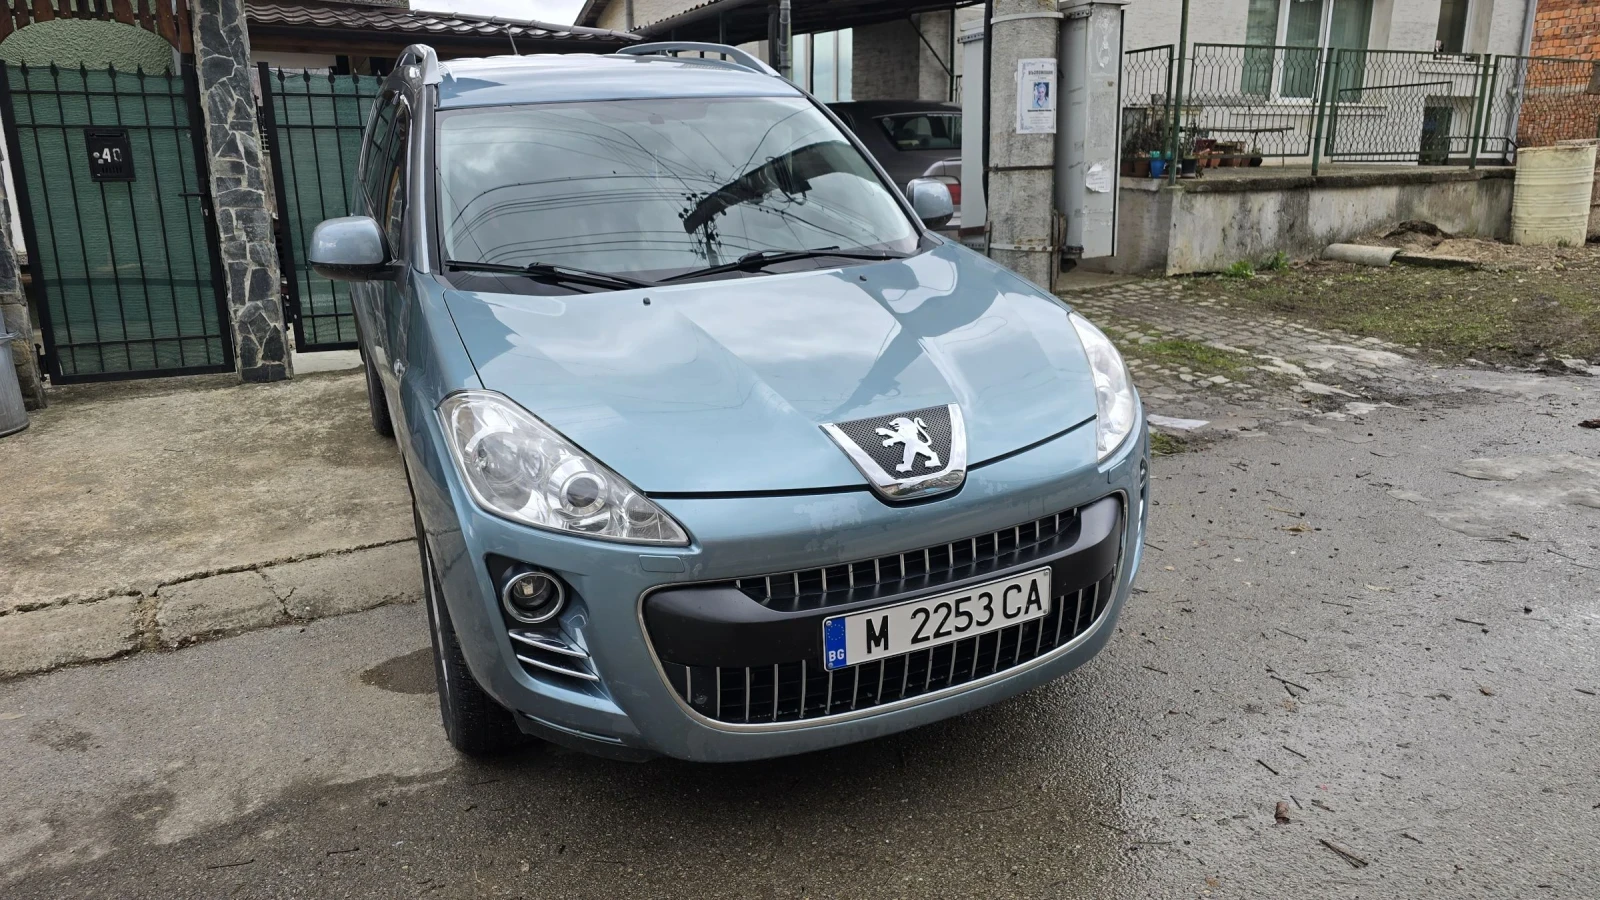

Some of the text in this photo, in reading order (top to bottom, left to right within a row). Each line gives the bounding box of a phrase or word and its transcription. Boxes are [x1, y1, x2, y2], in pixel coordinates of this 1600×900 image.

[866, 578, 1043, 654] M 2253 CA
[828, 648, 845, 662] BG
